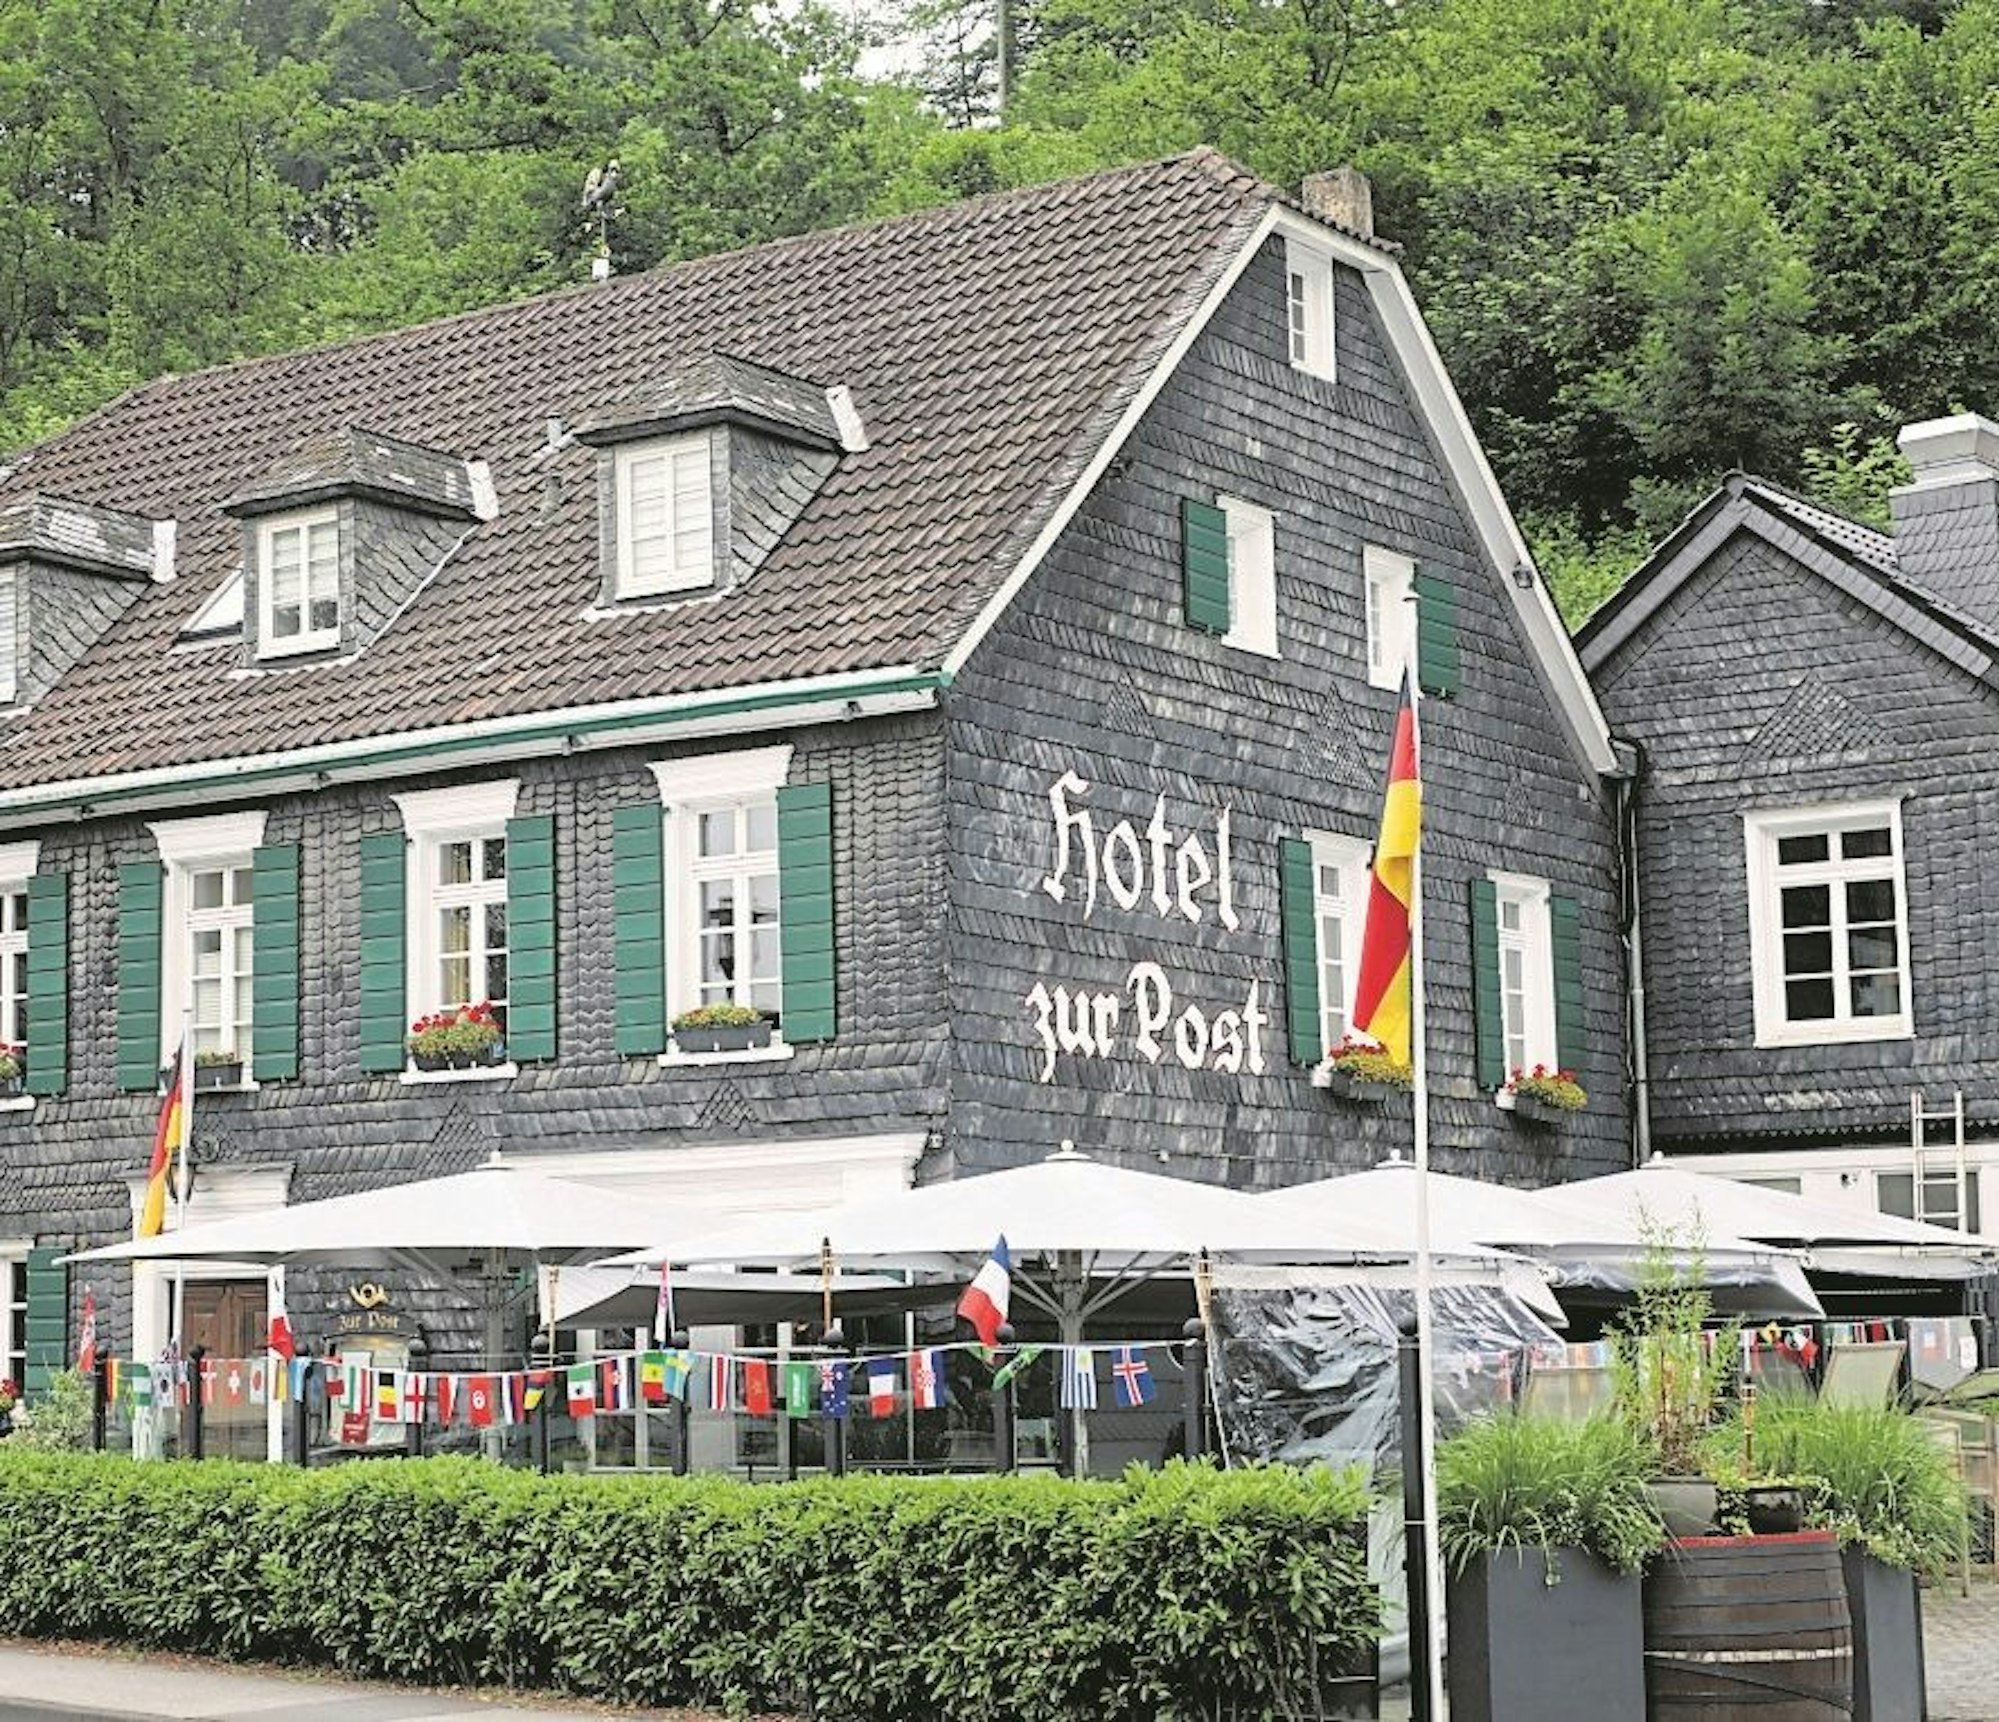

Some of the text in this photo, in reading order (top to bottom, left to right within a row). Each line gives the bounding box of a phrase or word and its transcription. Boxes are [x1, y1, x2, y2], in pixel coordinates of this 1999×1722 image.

[1042, 769, 1241, 934] Hotel
[1025, 961, 1268, 1083] zur Post
